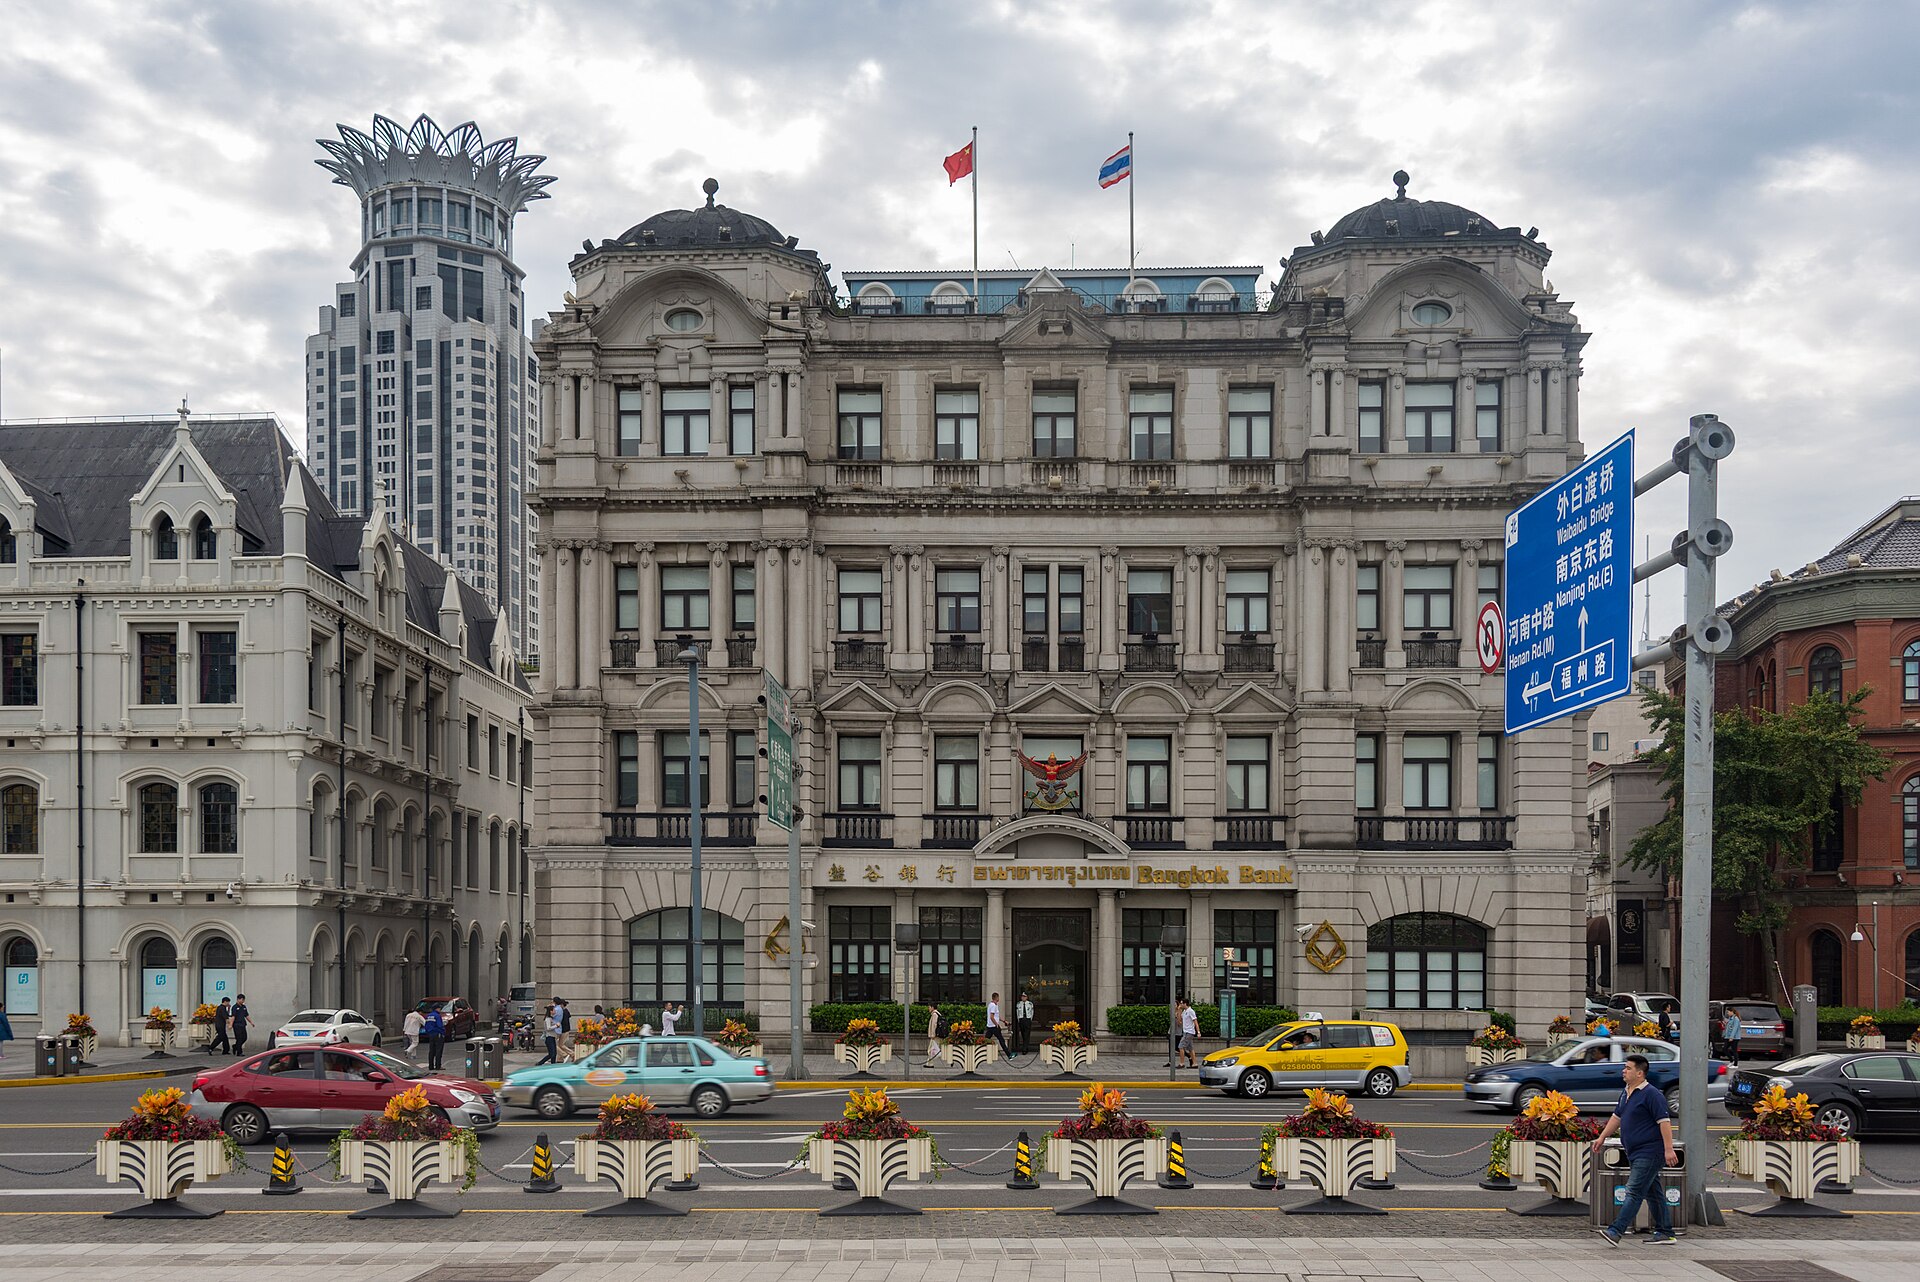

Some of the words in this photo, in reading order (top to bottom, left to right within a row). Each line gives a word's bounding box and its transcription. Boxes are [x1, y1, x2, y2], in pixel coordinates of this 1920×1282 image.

[1556, 460, 1614, 522] 外白渡桥
[1556, 516, 1587, 546] Waibaidu
[1590, 500, 1614, 524] Bridge
[1556, 528, 1613, 585] 南京东路
[1556, 584, 1585, 609] Nanjing
[1588, 564, 1613, 591] Rd.(E)
[1508, 601, 1555, 647] 河南中路
[1509, 647, 1530, 671] Henan
[1531, 635, 1555, 662] Rd.(M)
[1561, 652, 1606, 690] 福州路
[1530, 671, 1540, 687] 40
[1529, 697, 1538, 714] 17
[1137, 865, 1229, 888] Bangkok
[1239, 865, 1294, 884] Bank
